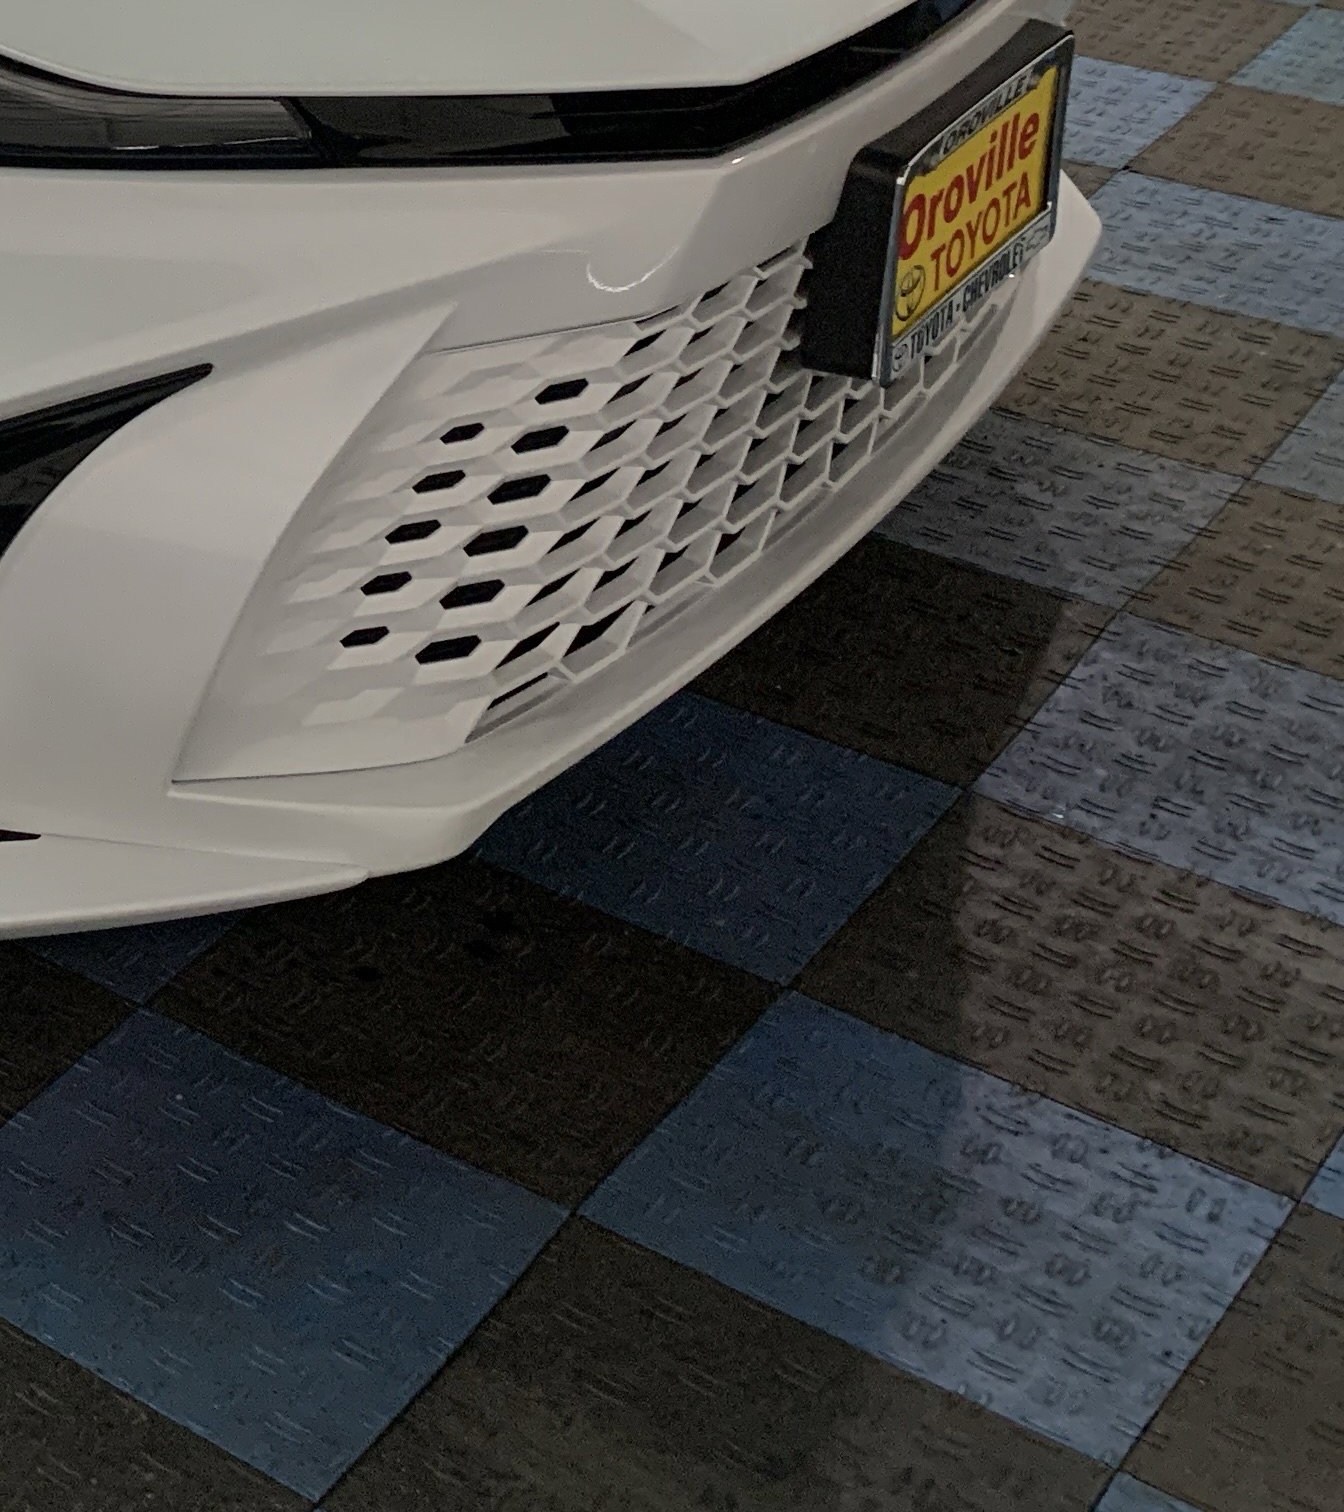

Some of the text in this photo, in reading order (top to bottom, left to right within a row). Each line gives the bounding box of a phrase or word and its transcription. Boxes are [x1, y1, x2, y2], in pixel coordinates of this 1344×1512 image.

[898, 112, 1040, 260] Oroville
[930, 171, 1031, 292] TOYOTA
[911, 242, 1024, 360] TOYOTA CHEVROLET
